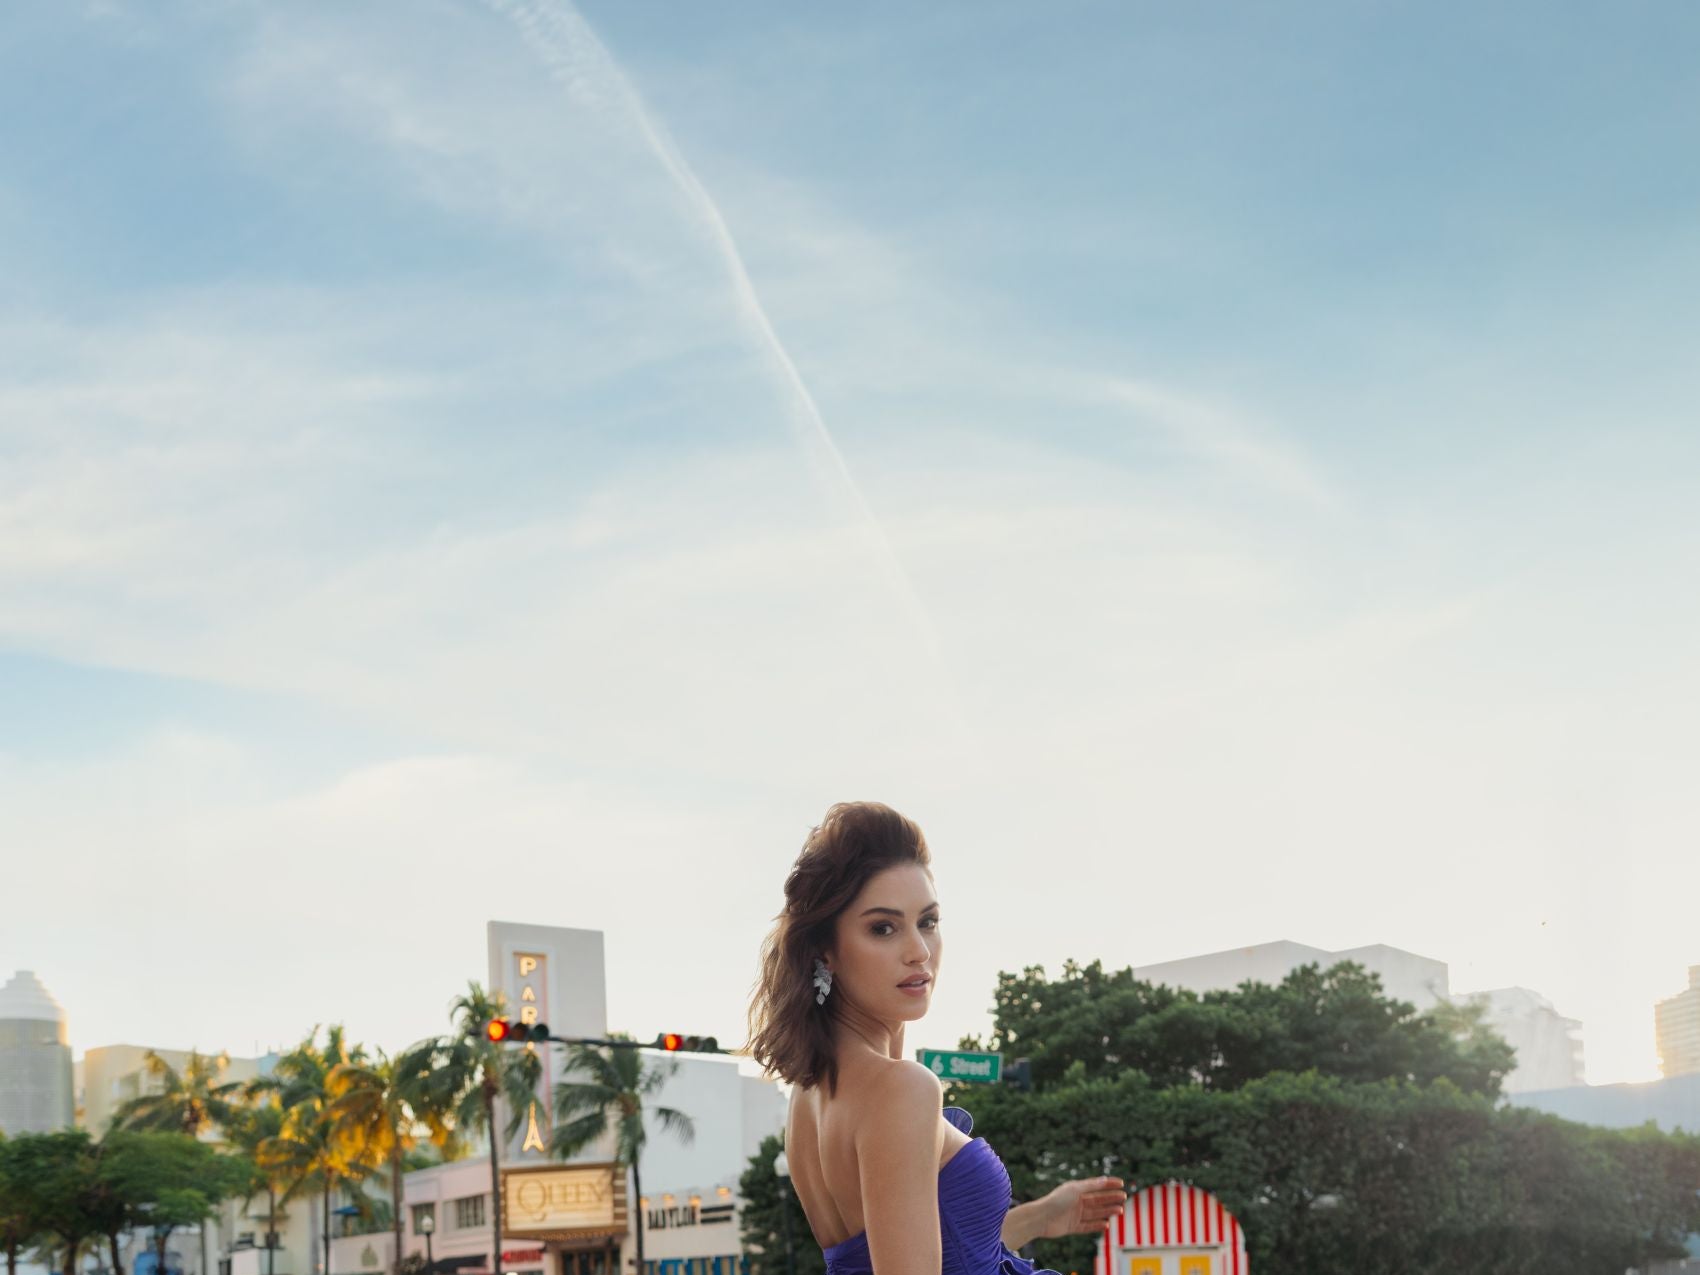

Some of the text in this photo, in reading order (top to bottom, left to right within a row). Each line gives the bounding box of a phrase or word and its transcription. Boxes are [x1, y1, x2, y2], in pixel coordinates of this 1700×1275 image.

[931, 1055, 991, 1076] 6 Street
[517, 1179, 607, 1222] QUEEN
